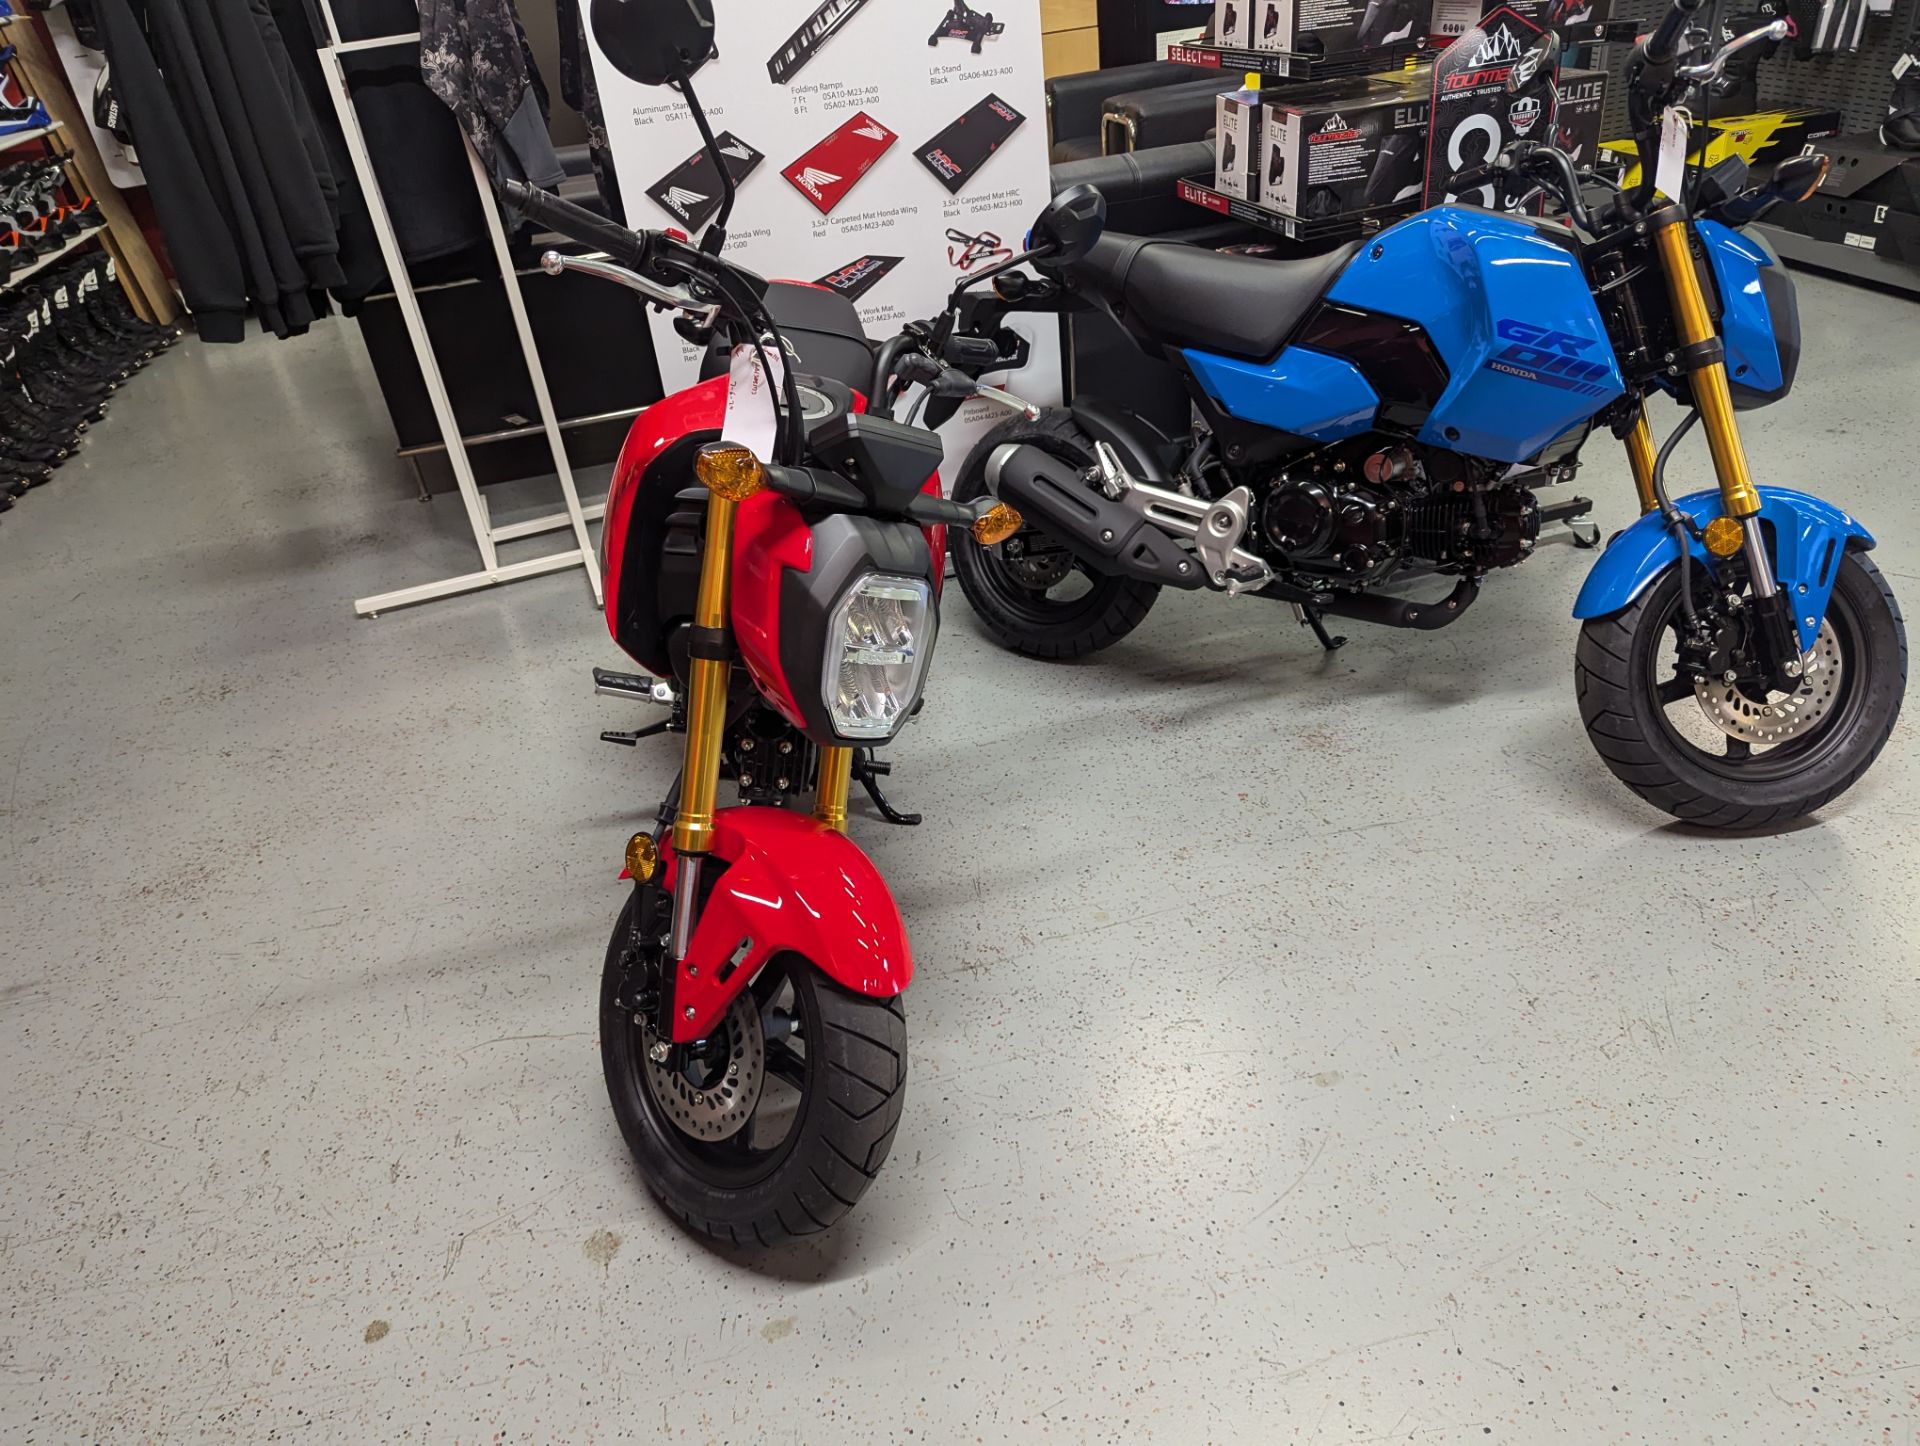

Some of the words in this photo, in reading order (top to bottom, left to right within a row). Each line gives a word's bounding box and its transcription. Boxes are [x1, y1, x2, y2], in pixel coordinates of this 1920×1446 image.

[1171, 47, 1202, 64] SELECT
[929, 66, 940, 76] Lift
[941, 64, 962, 74] Stand
[930, 75, 948, 86] Black
[1443, 66, 1514, 92] tourma
[791, 85, 819, 95] Folding
[819, 81, 844, 91] Ramps
[1441, 91, 1473, 101] AUTHENTIC
[1477, 86, 1501, 96] TRUSTED
[1558, 81, 1603, 101] ELITE
[799, 96, 806, 104] Ft
[632, 103, 671, 116] Aluminum
[671, 101, 690, 111] Stan
[793, 107, 799, 115] 8
[800, 105, 808, 114] Ft
[1394, 105, 1429, 125] ELI
[634, 116, 655, 126] Black
[1223, 114, 1238, 131] ELITE
[1270, 125, 1287, 142] ELITE
[795, 173, 823, 201] HONDA
[943, 199, 960, 208] 3.5x7
[961, 193, 991, 206] Carpeted
[992, 190, 1005, 200] Mat
[1005, 188, 1021, 198] HRC
[1184, 186, 1208, 205] ELITE
[660, 193, 690, 221] HONDA
[944, 209, 961, 218] Black
[811, 218, 829, 228] 3.5x7
[830, 212, 861, 227] Carpeted
[862, 210, 876, 220] Mat
[876, 207, 899, 218] Honda
[900, 205, 918, 216] Wing
[728, 230, 752, 241] Honda
[752, 228, 771, 238] Wing
[812, 229, 826, 238] Red
[862, 306, 881, 316] Work
[881, 304, 894, 313] Mat
[684, 354, 698, 363] Red
[1491, 362, 1538, 380] HONDA
[963, 405, 990, 416] Pitboard
